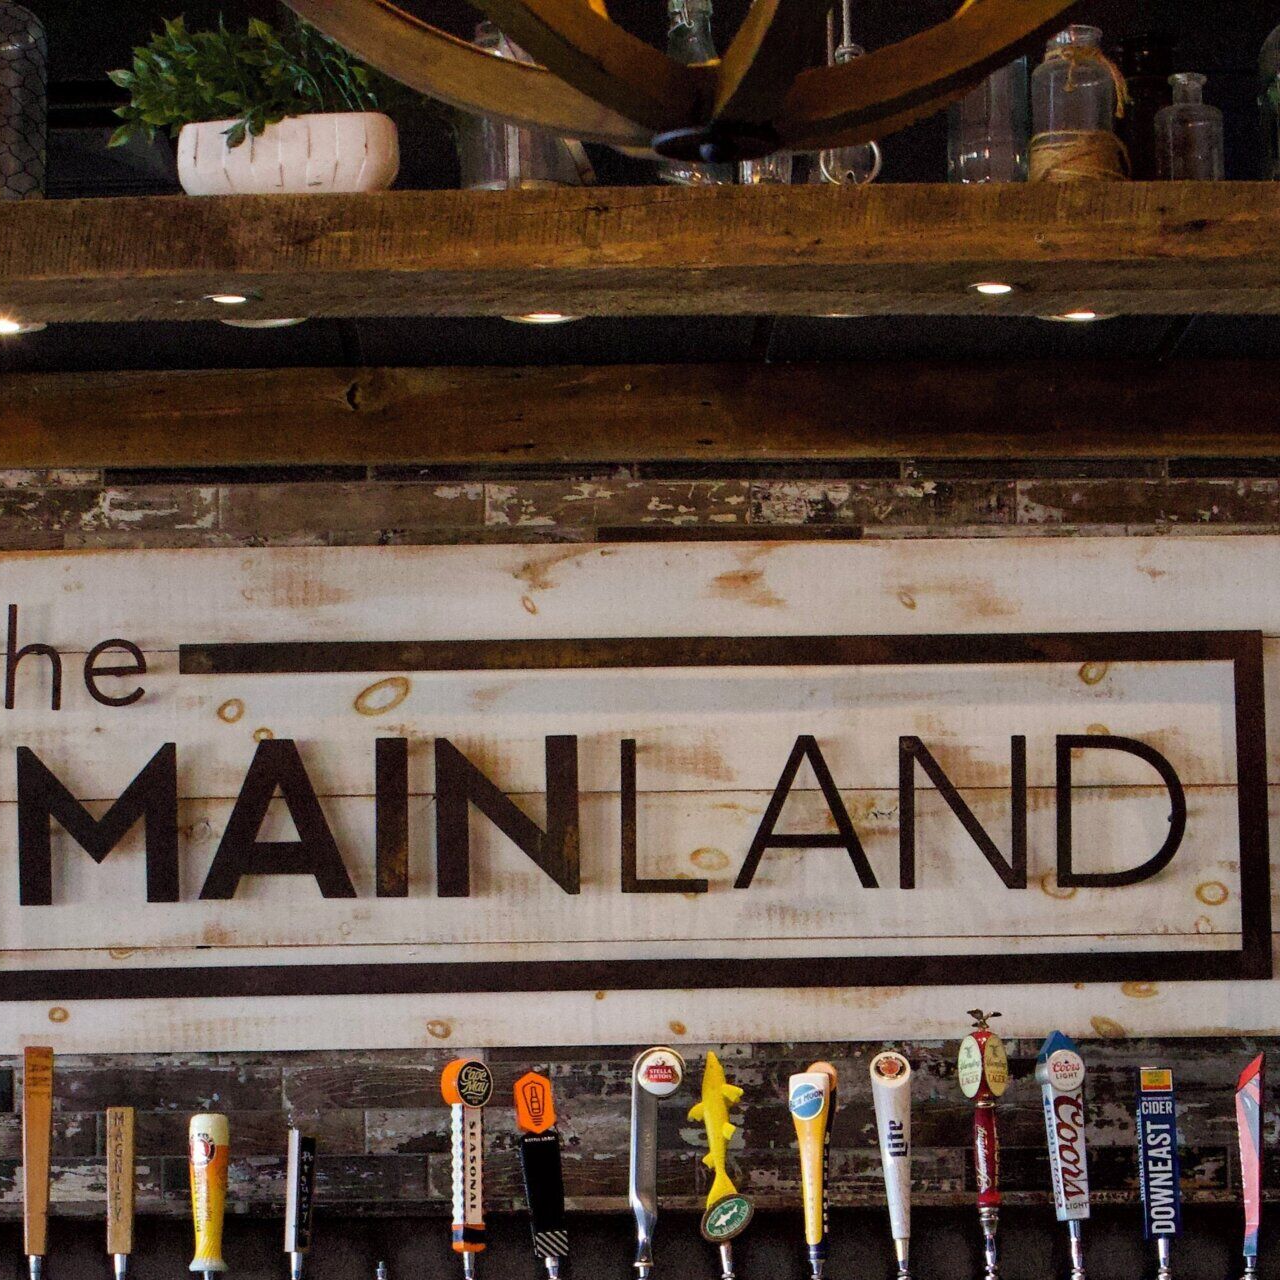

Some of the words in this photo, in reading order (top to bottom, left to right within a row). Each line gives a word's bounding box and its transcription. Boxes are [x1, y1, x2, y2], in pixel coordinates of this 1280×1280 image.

[16, 733, 1188, 907] MAINLAND
[461, 1066, 489, 1082] Cape
[1052, 1061, 1080, 1072] Coors
[1056, 1072, 1078, 1080] LIGHT
[459, 1080, 489, 1097] May
[1141, 1101, 1173, 1115] CIDER
[887, 1119, 908, 1158] Lite
[1053, 1093, 1085, 1201] Coors
[114, 1112, 125, 1221] MAGNIFY
[469, 1121, 478, 1211] SEASONAL
[1146, 1121, 1176, 1234] DOWNEAST
[1065, 1202, 1090, 1210] LIGHT
